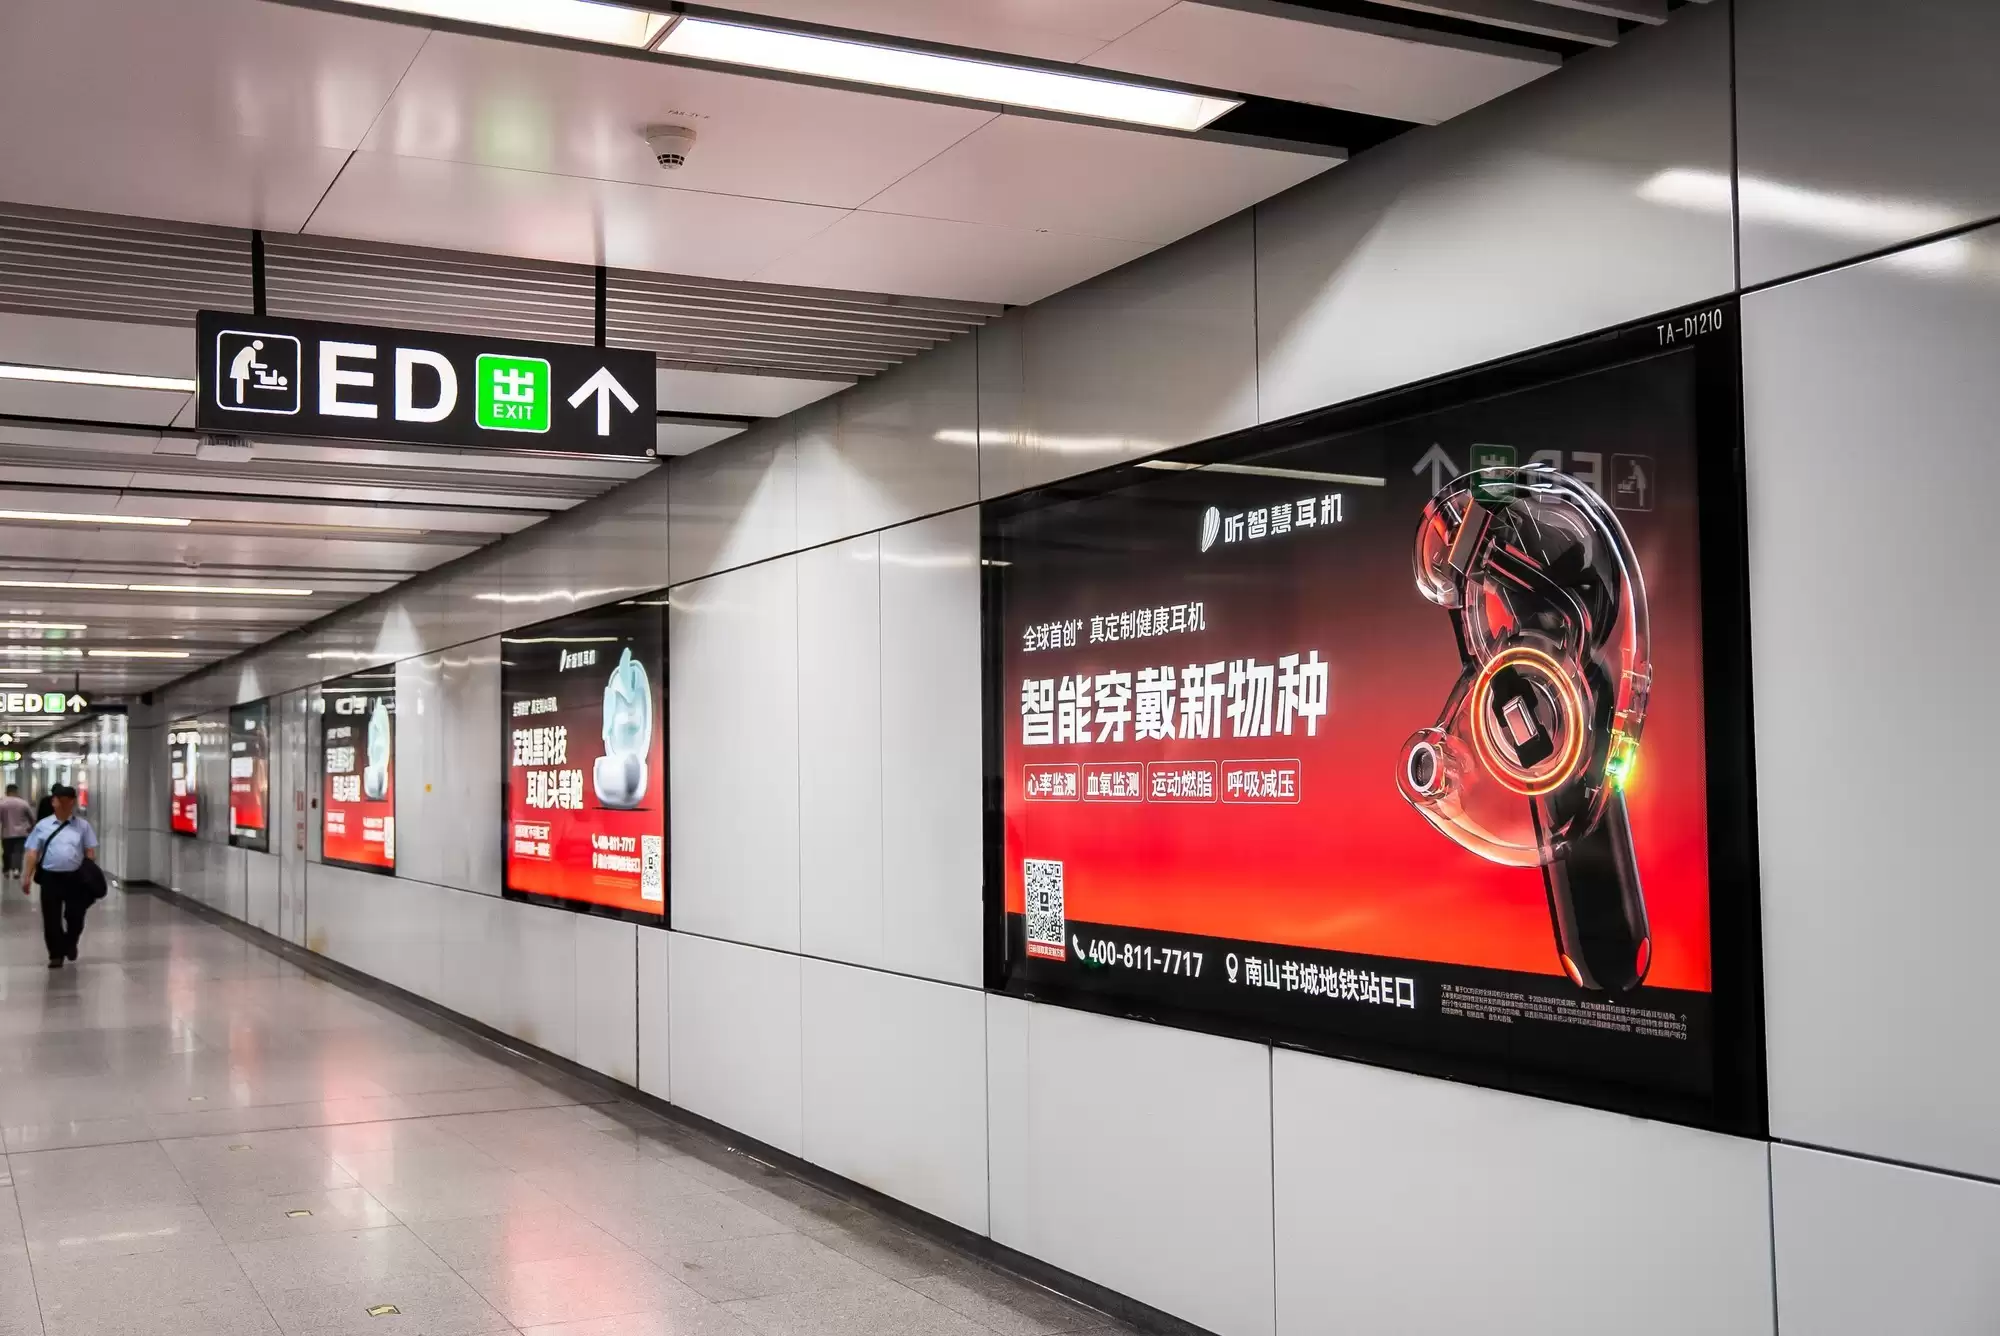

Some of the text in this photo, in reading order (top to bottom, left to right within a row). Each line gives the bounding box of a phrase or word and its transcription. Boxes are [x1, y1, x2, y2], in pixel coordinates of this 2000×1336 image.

[1657, 308, 1723, 346] TA-D1210
[318, 340, 458, 423] ED
[493, 368, 535, 403] 出
[493, 403, 534, 421] EXIT
[1224, 493, 1343, 543] 听智慧耳机
[1089, 601, 1206, 644] 真定制健康耳机
[7, 693, 44, 713] ED
[1021, 650, 1329, 746] 智能穿戴新物种
[512, 725, 568, 767] 定制黑科技
[1027, 772, 1077, 797] 心率监测
[1086, 771, 1140, 797] 血氧监测
[1151, 771, 1213, 797] 运动燃脂
[1226, 769, 1296, 798] 呼吸减压
[1088, 939, 1204, 978] 400-811-7717
[1244, 956, 1417, 1010] 南山书城地铁站E口
